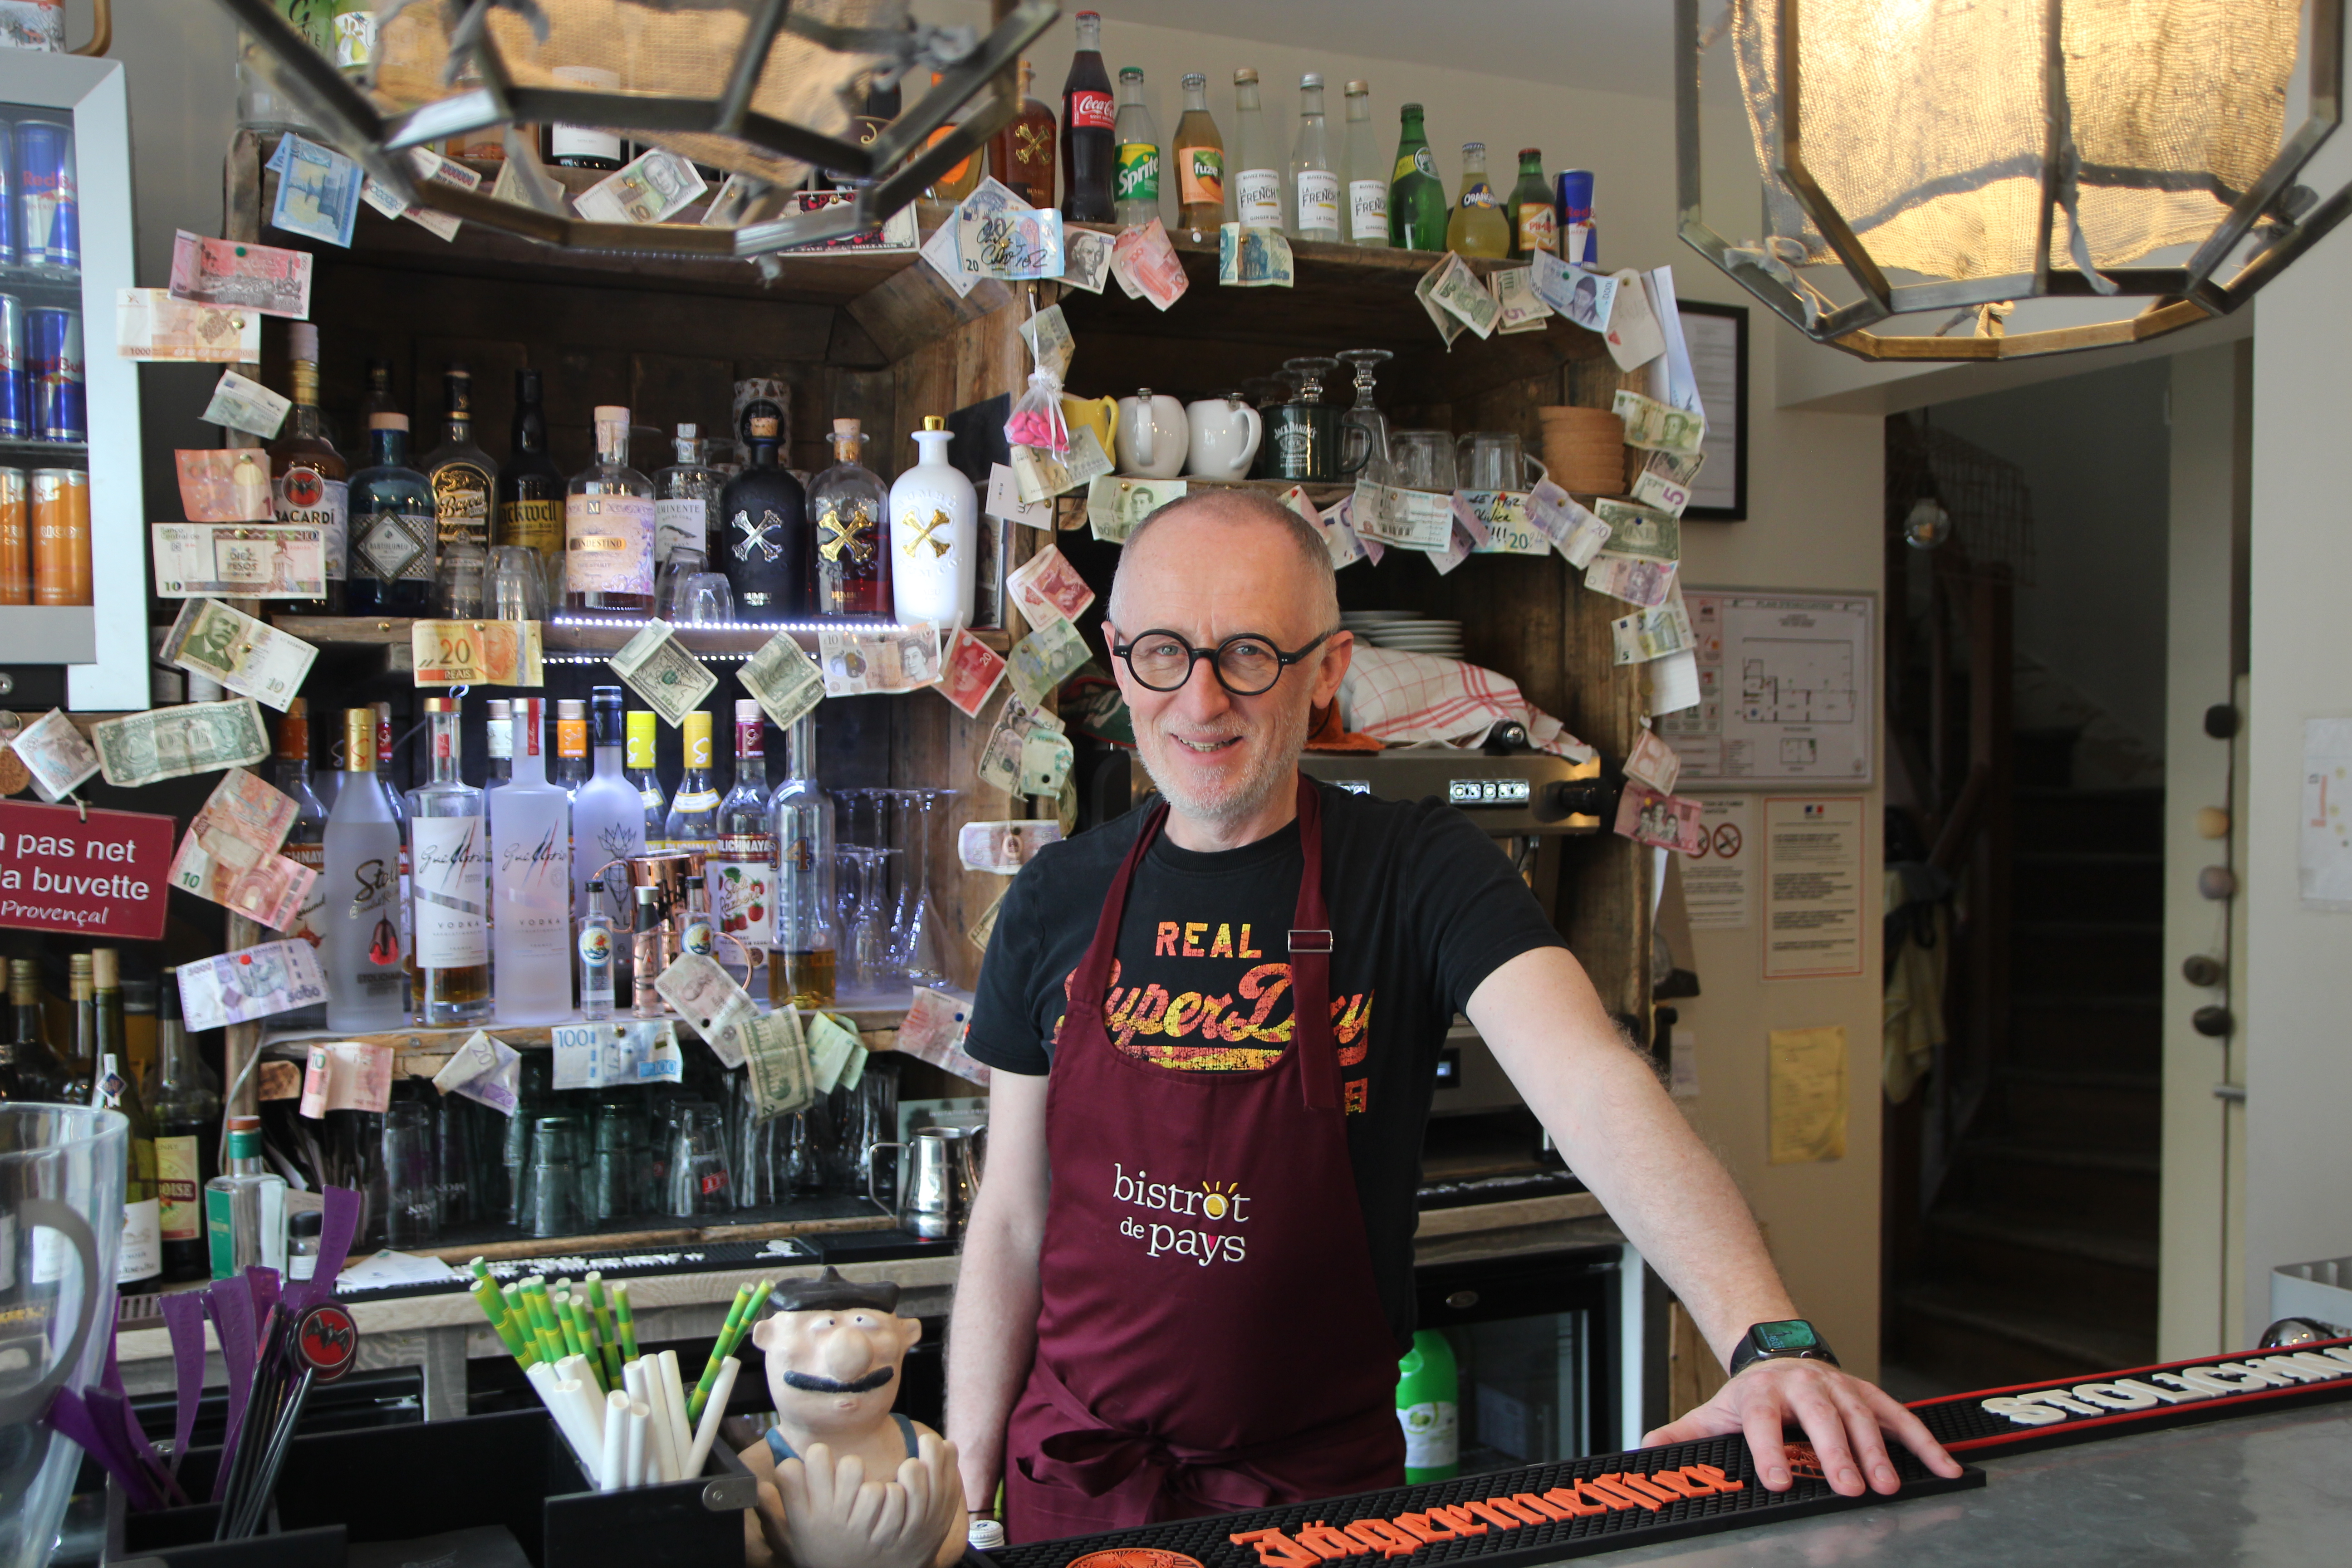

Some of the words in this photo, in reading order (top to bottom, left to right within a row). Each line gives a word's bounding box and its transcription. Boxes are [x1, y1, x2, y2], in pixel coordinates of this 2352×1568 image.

[1118, 154, 1159, 195] Sprite
[1194, 162, 1218, 175] fuze
[23, 171, 55, 187] Red
[1240, 186, 1277, 209] FRENCH
[1302, 189, 1337, 207] FRENCH
[630, 204, 650, 221] 10
[1565, 206, 1589, 218] Red
[966, 259, 979, 271] 20
[129, 347, 151, 356] 1000
[1663, 486, 1685, 506] 5
[588, 502, 599, 513] M
[657, 504, 700, 513] EMINENTE
[300, 530, 317, 540] 10
[1591, 520, 1608, 538] 20
[1509, 533, 1529, 549] 20
[230, 552, 252, 561] DIEZ
[227, 563, 256, 571] PESOS
[165, 581, 181, 592] 10
[439, 638, 470, 664] 20
[980, 652, 992, 666] 20
[1622, 650, 1630, 660] 5
[445, 669, 472, 679] REAIS
[265, 676, 284, 694] 10
[692, 737, 710, 764] S
[17, 834, 75, 858] pas
[86, 838, 136, 863] net
[33, 866, 150, 901] buvette
[181, 871, 201, 888] 10
[1, 900, 109, 927] Provençal
[1155, 921, 1262, 958] REAL
[557, 1030, 589, 1048] 100
[311, 1054, 325, 1069] 10
[472, 1043, 493, 1065] 20
[653, 1060, 676, 1073] 100
[495, 1090, 515, 1107] 20
[1113, 1163, 1251, 1222] bistrot
[1120, 1216, 1145, 1240] de
[1147, 1224, 1246, 1267] pays
